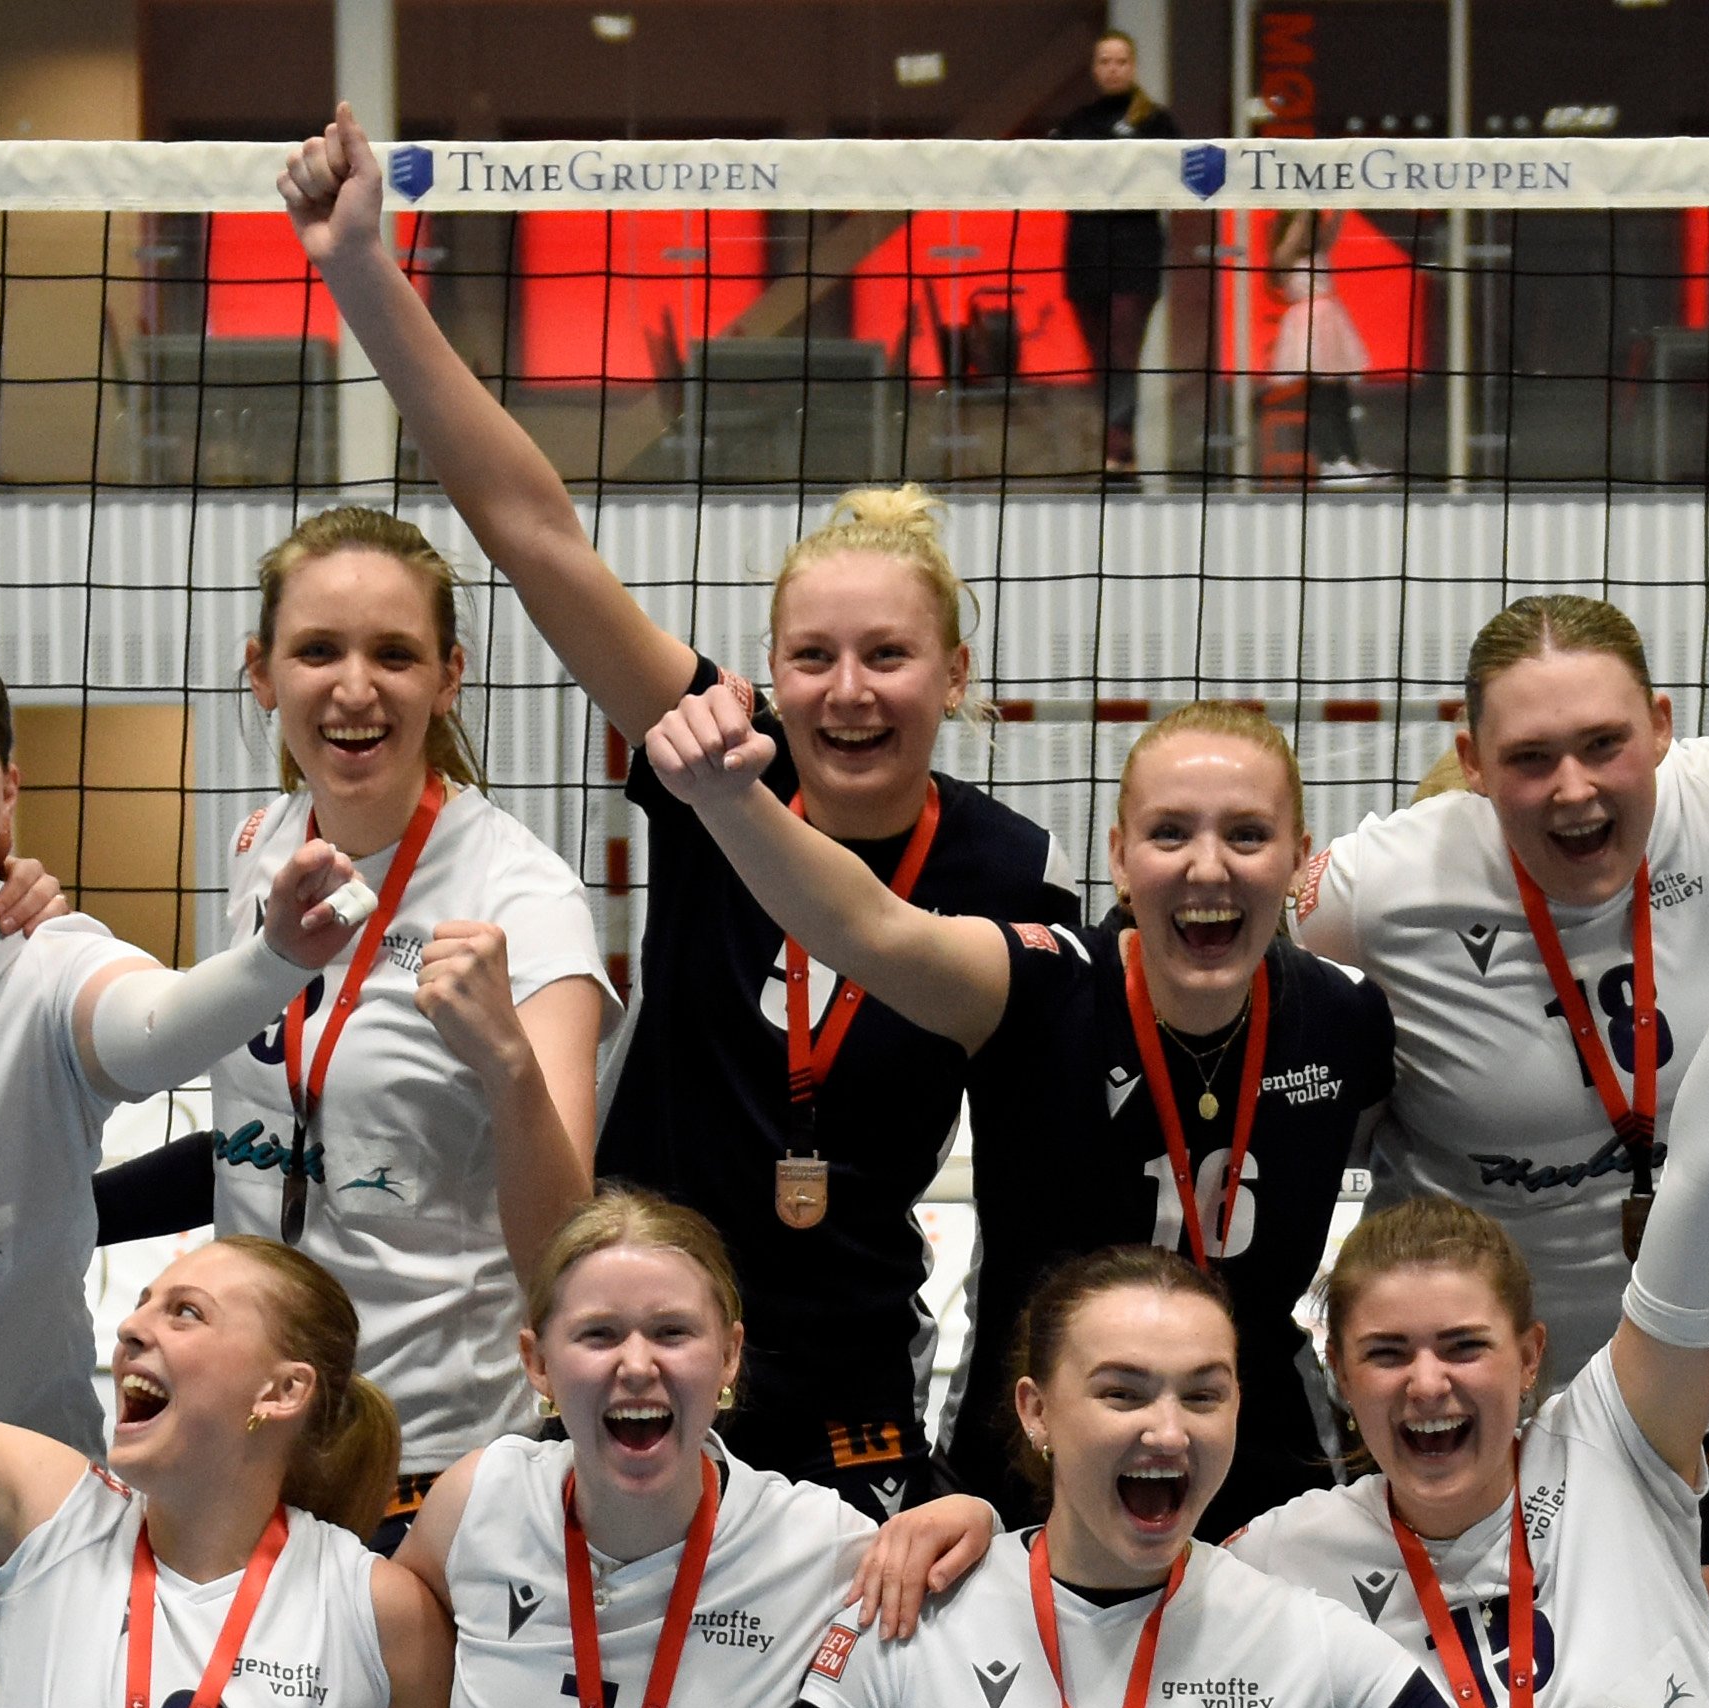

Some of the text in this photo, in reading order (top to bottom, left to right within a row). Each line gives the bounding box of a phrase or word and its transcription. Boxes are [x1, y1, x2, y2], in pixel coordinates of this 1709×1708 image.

[1544, 963, 1674, 1088] 18
[1260, 1063, 1329, 1092] entofte
[1285, 1079, 1343, 1105] volley
[1143, 1148, 1259, 1258] 16
[693, 1611, 762, 1631] ntofte
[701, 1629, 776, 1654] volley
[232, 1654, 322, 1683] gentofte
[1161, 1677, 1260, 1701] gentofte
